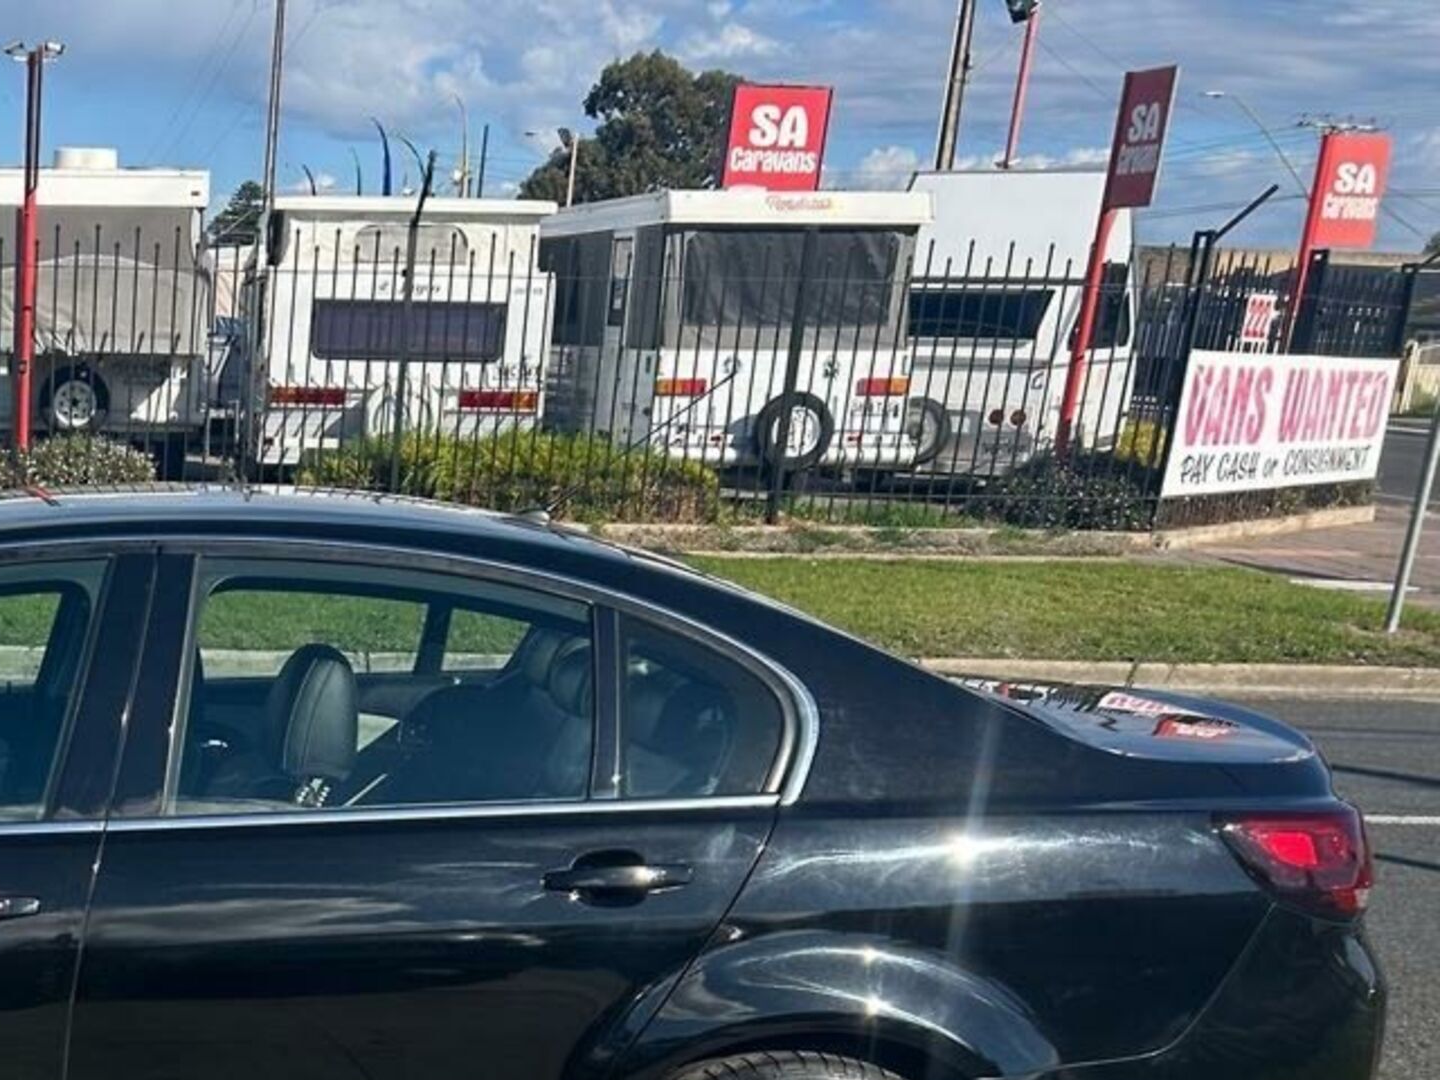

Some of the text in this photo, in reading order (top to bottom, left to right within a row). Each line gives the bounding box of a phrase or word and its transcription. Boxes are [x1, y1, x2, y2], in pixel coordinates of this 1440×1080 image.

[748, 103, 809, 148] SA
[1127, 101, 1160, 143] SA
[729, 146, 817, 174] Caravans
[1333, 162, 1376, 194] SA
[1242, 297, 1272, 338] 222
[1183, 363, 1389, 447] VANS WANTED
[1180, 453, 1216, 485] PAY
[1216, 451, 1261, 482] CASH
[1282, 445, 1372, 476] CONSIGNMENT
